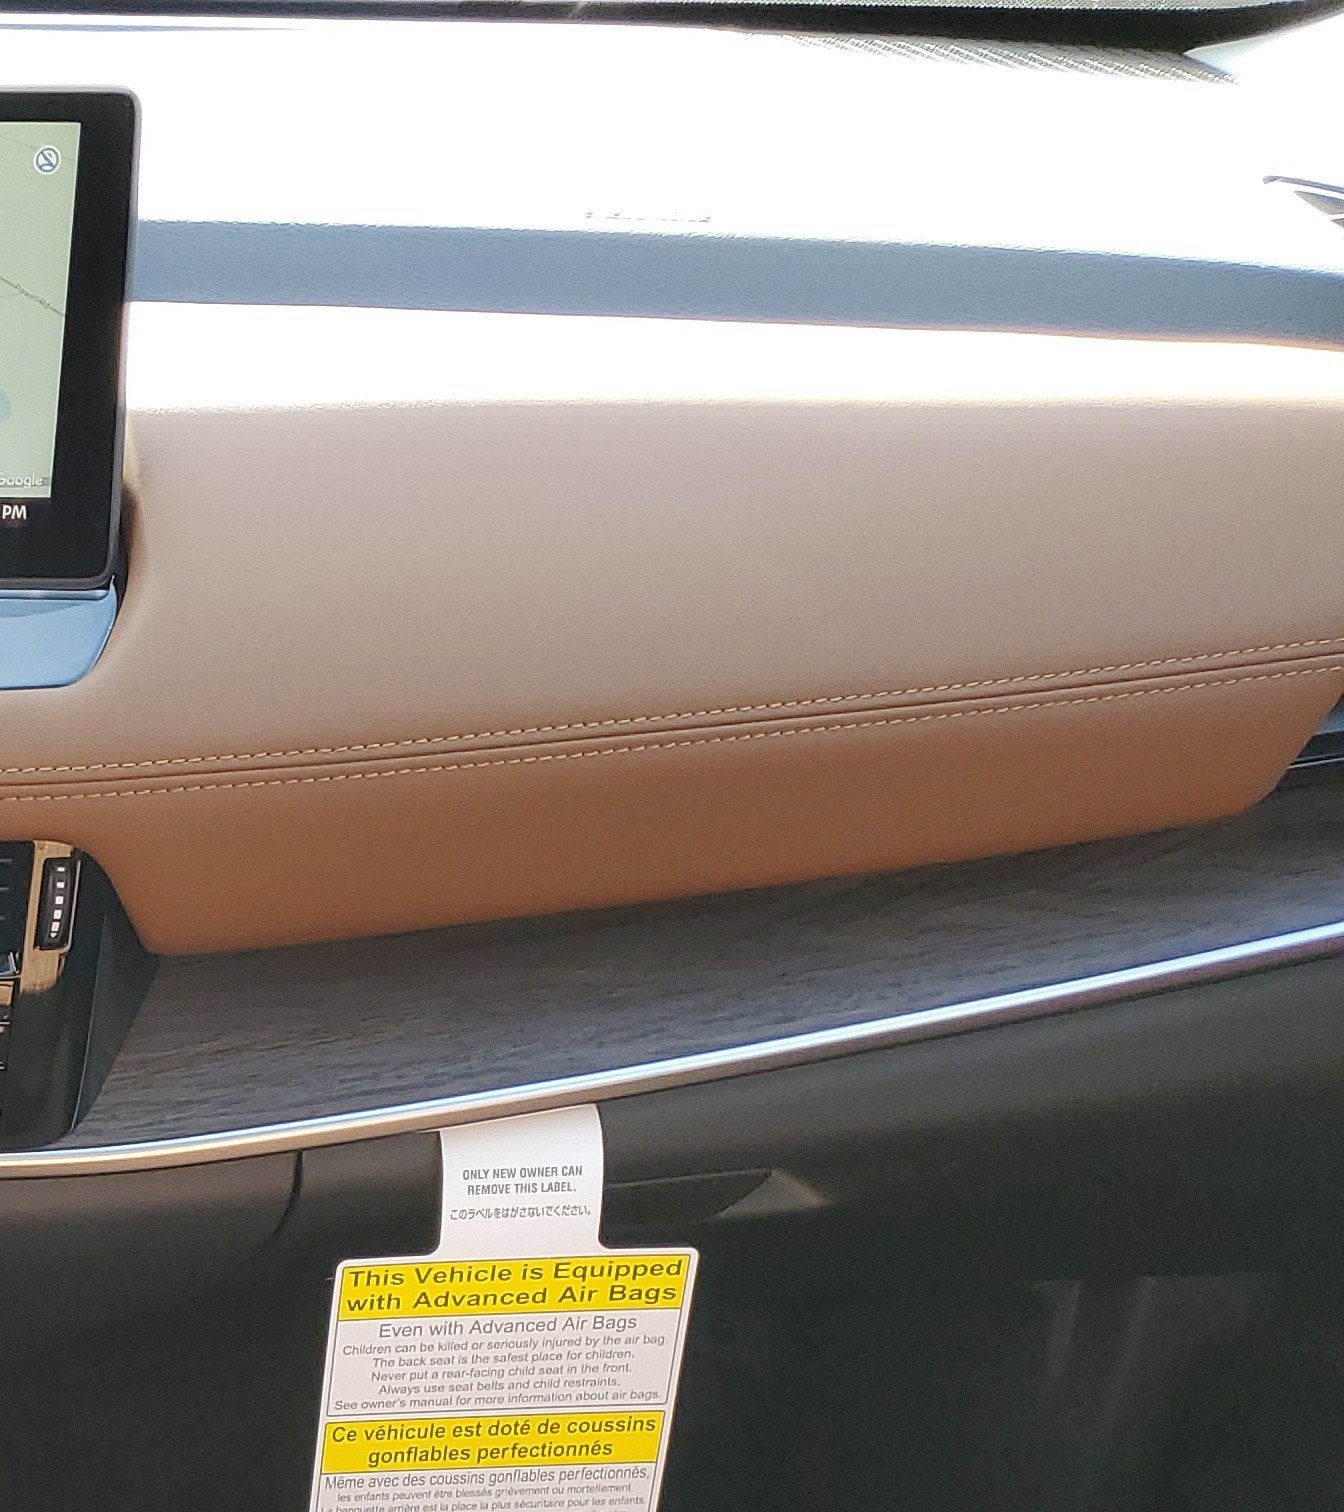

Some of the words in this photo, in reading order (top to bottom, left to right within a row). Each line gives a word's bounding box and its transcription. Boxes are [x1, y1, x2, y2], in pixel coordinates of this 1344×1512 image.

[2, 505, 27, 520] PM
[463, 1169, 489, 1180] ONLY
[493, 1168, 516, 1179] NEW
[520, 1166, 558, 1178] OWNER
[562, 1165, 582, 1176] CAN
[468, 1183, 510, 1195] REMOVE
[514, 1182, 537, 1193] THIS
[541, 1181, 575, 1193] LABEL.
[349, 1267, 405, 1286] This
[415, 1264, 511, 1284] Vehicle
[522, 1263, 543, 1280] is
[553, 1258, 682, 1284] Equipped
[347, 1292, 400, 1310] with
[412, 1287, 547, 1308] Advanced
[558, 1285, 598, 1303] Air
[609, 1283, 677, 1306] Bags
[379, 1321, 422, 1337] Even
[429, 1320, 463, 1336] with
[469, 1317, 556, 1334] Advanced
[562, 1316, 588, 1331] Air
[593, 1314, 637, 1333] Bags
[343, 1343, 391, 1355] Children
[395, 1345, 415, 1353] can
[420, 1341, 434, 1352] be
[438, 1340, 467, 1351] killed
[472, 1342, 484, 1350] or
[487, 1338, 538, 1352] seriously
[542, 1336, 581, 1350] injured
[586, 1336, 599, 1349] by
[604, 1335, 620, 1346] the
[624, 1335, 639, 1345] air
[373, 1357, 394, 1367] The
[399, 1355, 426, 1366] back
[430, 1354, 454, 1365] seat
[458, 1354, 467, 1364] is
[472, 1353, 489, 1364] the
[493, 1352, 528, 1363] safest
[532, 1351, 562, 1364] place
[566, 1350, 581, 1360] for
[586, 1348, 634, 1360] children.
[372, 1370, 406, 1381] Never
[410, 1369, 428, 1382] put
[432, 1371, 438, 1379] a
[443, 1367, 504, 1381] rear-facing
[508, 1366, 535, 1376] child
[539, 1365, 563, 1375] seat
[568, 1364, 576, 1374] in
[581, 1363, 599, 1374] the
[603, 1362, 632, 1373] front.
[379, 1383, 420, 1397] Always
[424, 1385, 444, 1393] use
[449, 1381, 473, 1392] seat
[477, 1380, 504, 1391] belts
[508, 1380, 529, 1390] and
[533, 1379, 560, 1389] child
[564, 1376, 620, 1388] restraints.
[335, 1399, 357, 1410] See
[361, 1398, 405, 1409] owner's
[410, 1396, 452, 1407] manual
[456, 1395, 470, 1405] for
[475, 1396, 504, 1405] more
[508, 1392, 572, 1404] information
[576, 1391, 608, 1401] about
[612, 1390, 626, 1400] air
[332, 1426, 357, 1441] Ce
[364, 1423, 446, 1440] véhicule
[452, 1421, 482, 1437] est
[488, 1420, 530, 1436] doté
[537, 1419, 560, 1434] de
[567, 1415, 656, 1433] coussins
[368, 1445, 471, 1468] gonflables
[477, 1440, 613, 1464] perfectionnés
[368, 1477, 398, 1488] avec
[403, 1473, 425, 1487] des
[430, 1471, 484, 1486] coussins
[489, 1469, 554, 1486] gonflables
[559, 1466, 650, 1484] perfectionnés,
